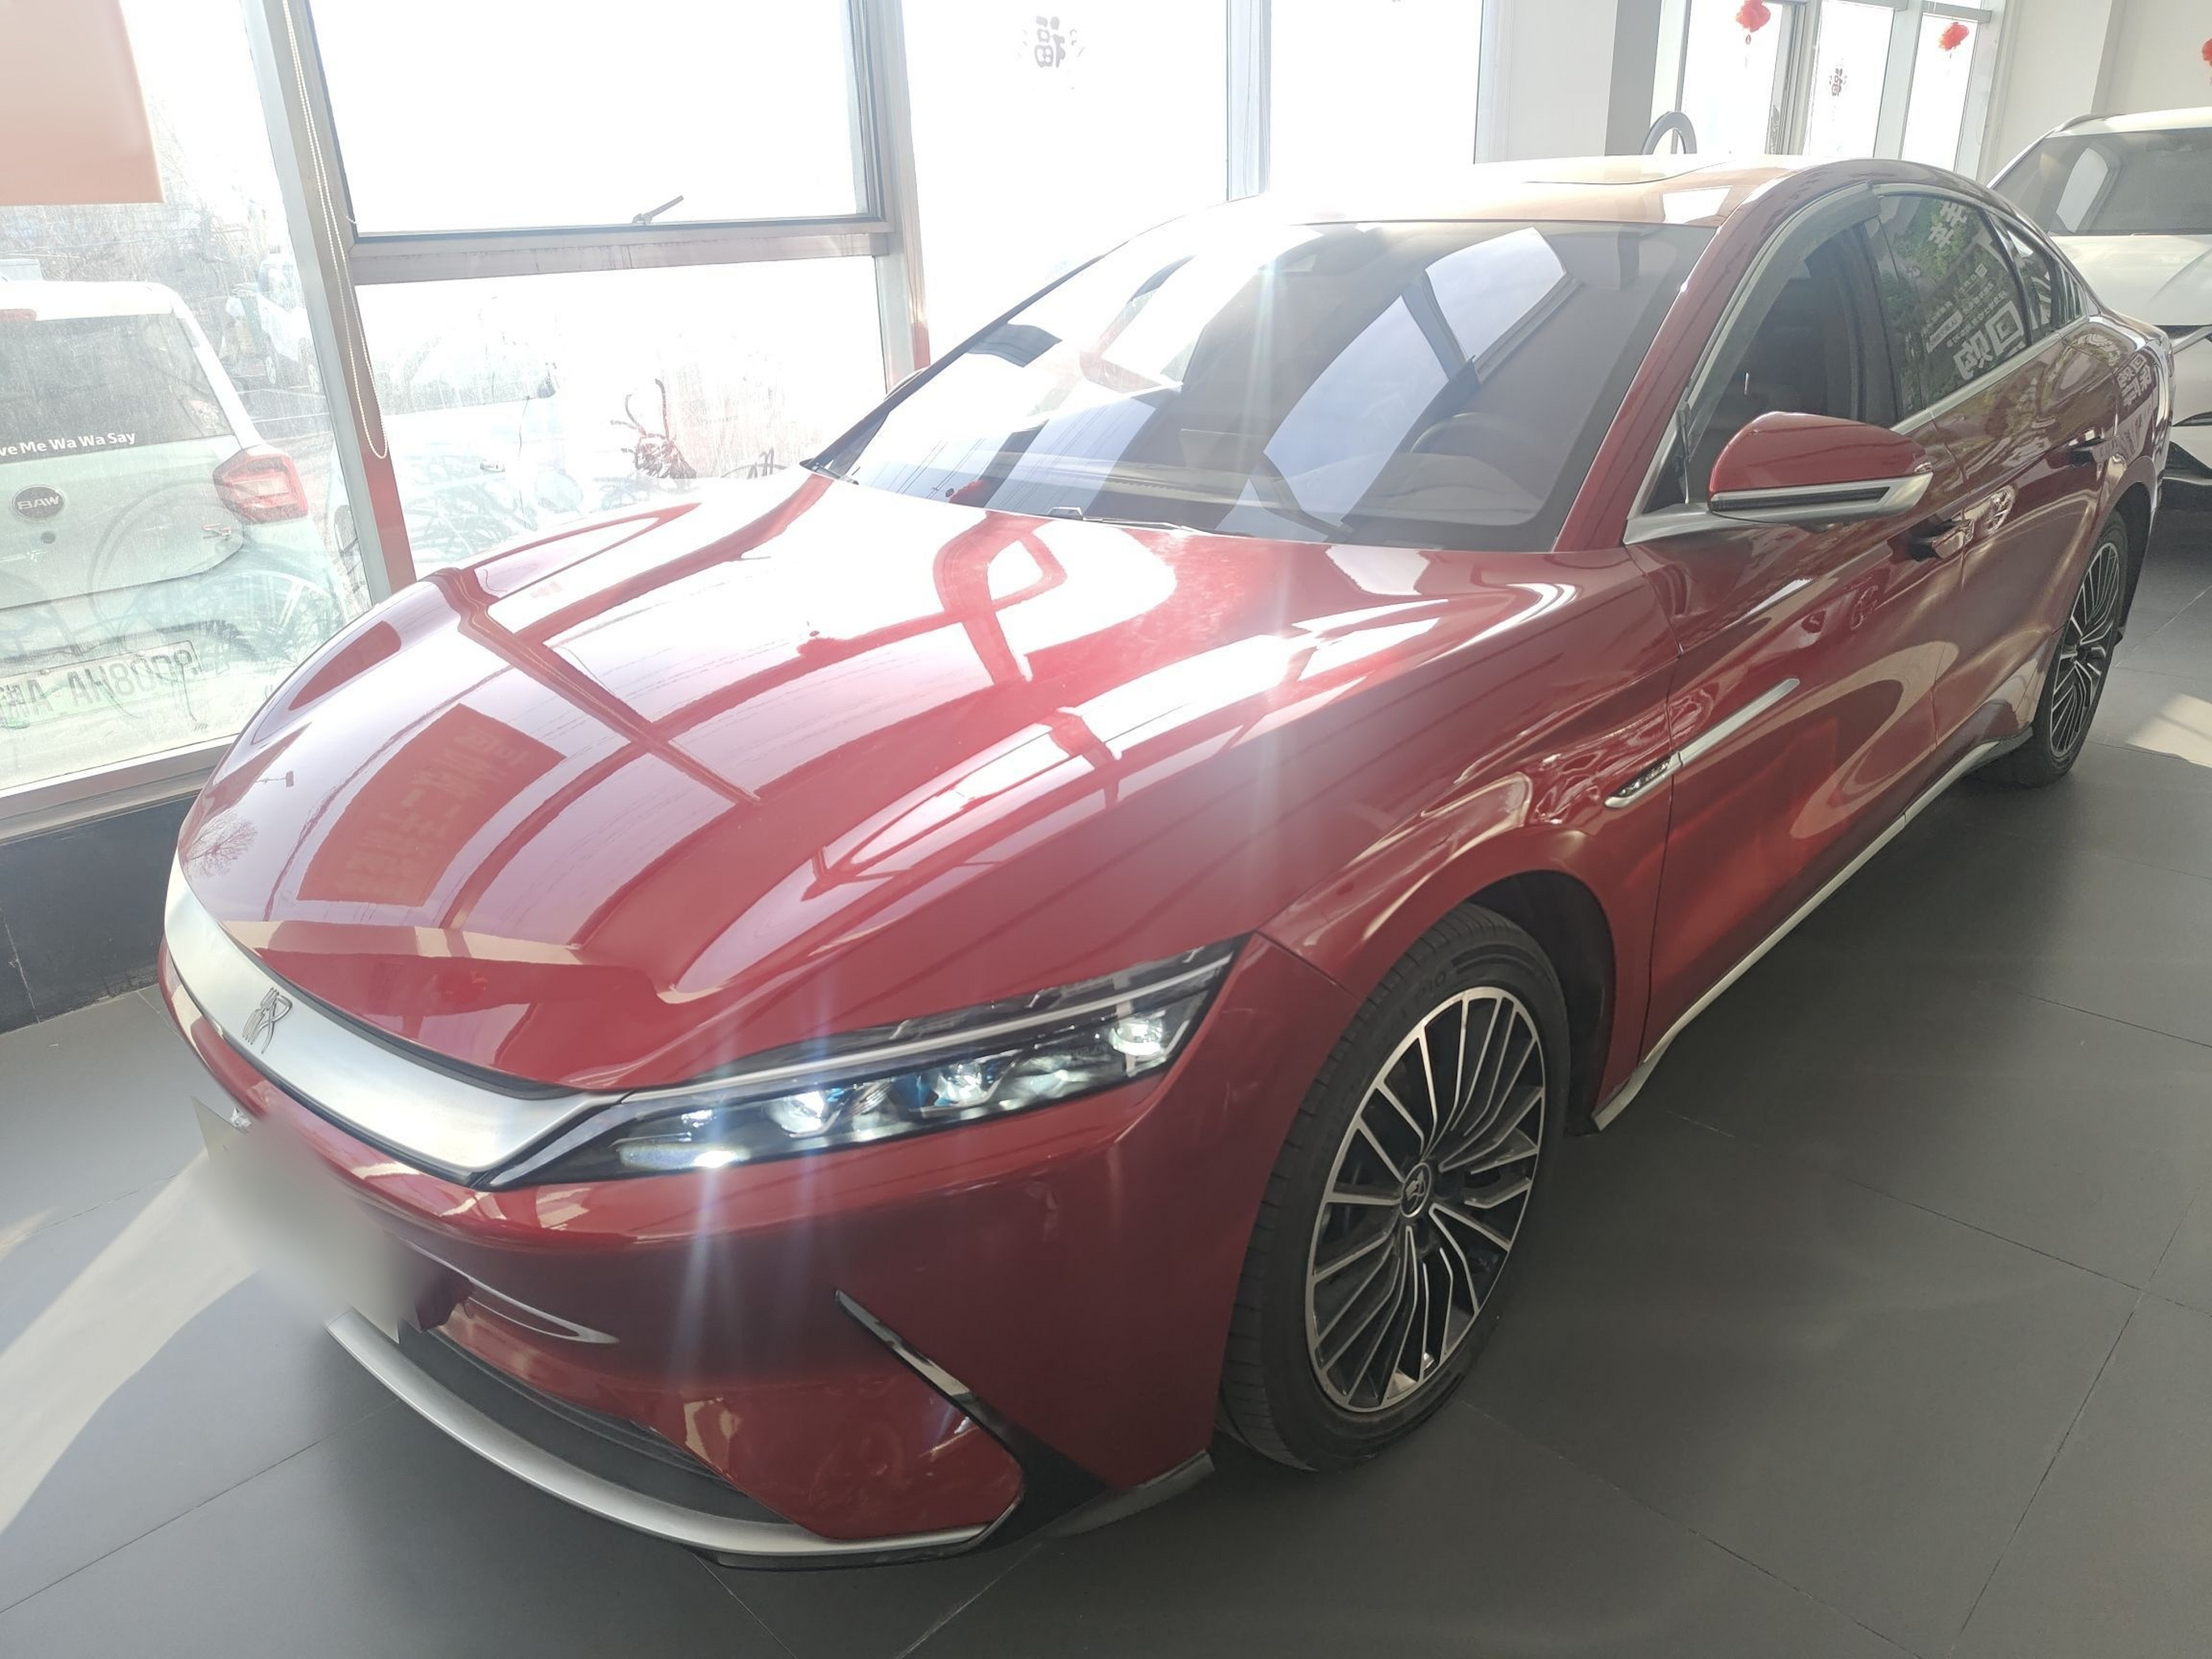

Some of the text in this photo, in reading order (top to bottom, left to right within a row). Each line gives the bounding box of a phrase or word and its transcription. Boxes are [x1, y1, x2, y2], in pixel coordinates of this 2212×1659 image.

[19, 441, 47, 454] Me
[48, 438, 77, 450] Wa
[78, 434, 106, 447] Wa
[107, 433, 136, 445] Say
[17, 495, 60, 510] BAW
